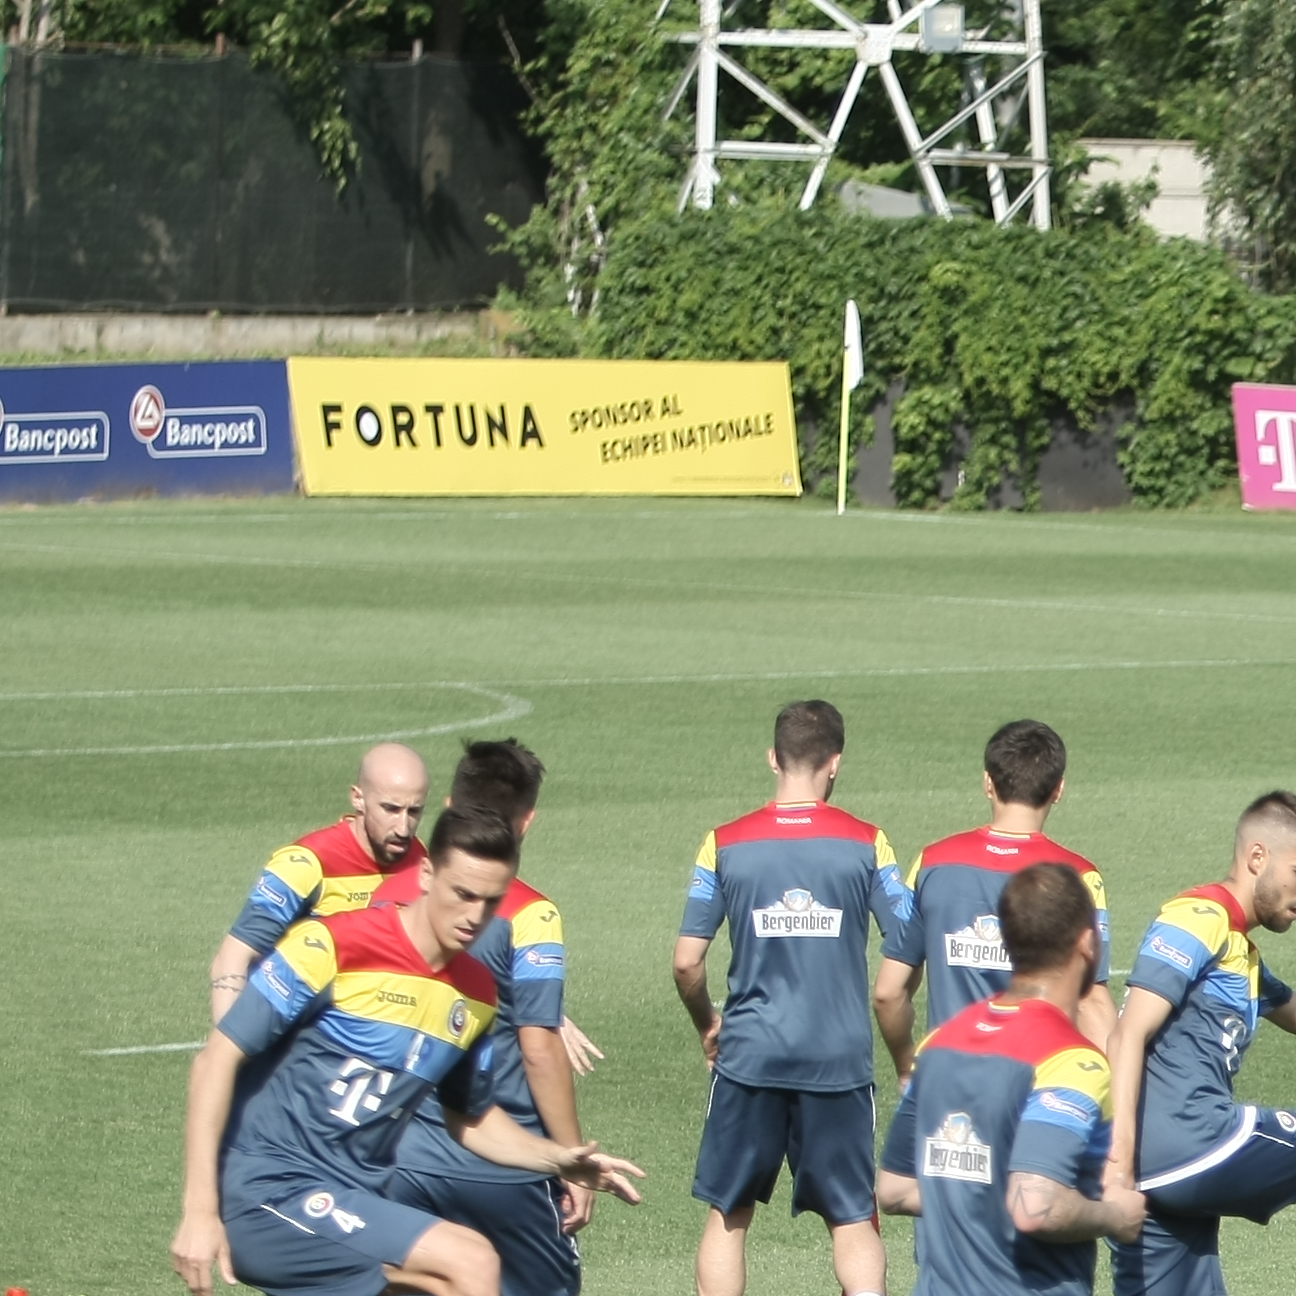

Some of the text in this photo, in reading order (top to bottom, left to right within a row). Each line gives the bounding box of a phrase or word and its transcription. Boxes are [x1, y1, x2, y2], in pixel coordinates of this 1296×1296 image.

[321, 403, 545, 447] FORTUNA
[569, 394, 684, 434] SPONSOR AL
[5, 423, 98, 456] Bancpost
[166, 417, 256, 450] Bancpost
[600, 431, 667, 464] ECHIPEI
[762, 913, 834, 932] Bergenbier
[950, 939, 1012, 963] Bergenb
[332, 1208, 366, 1233] 4
